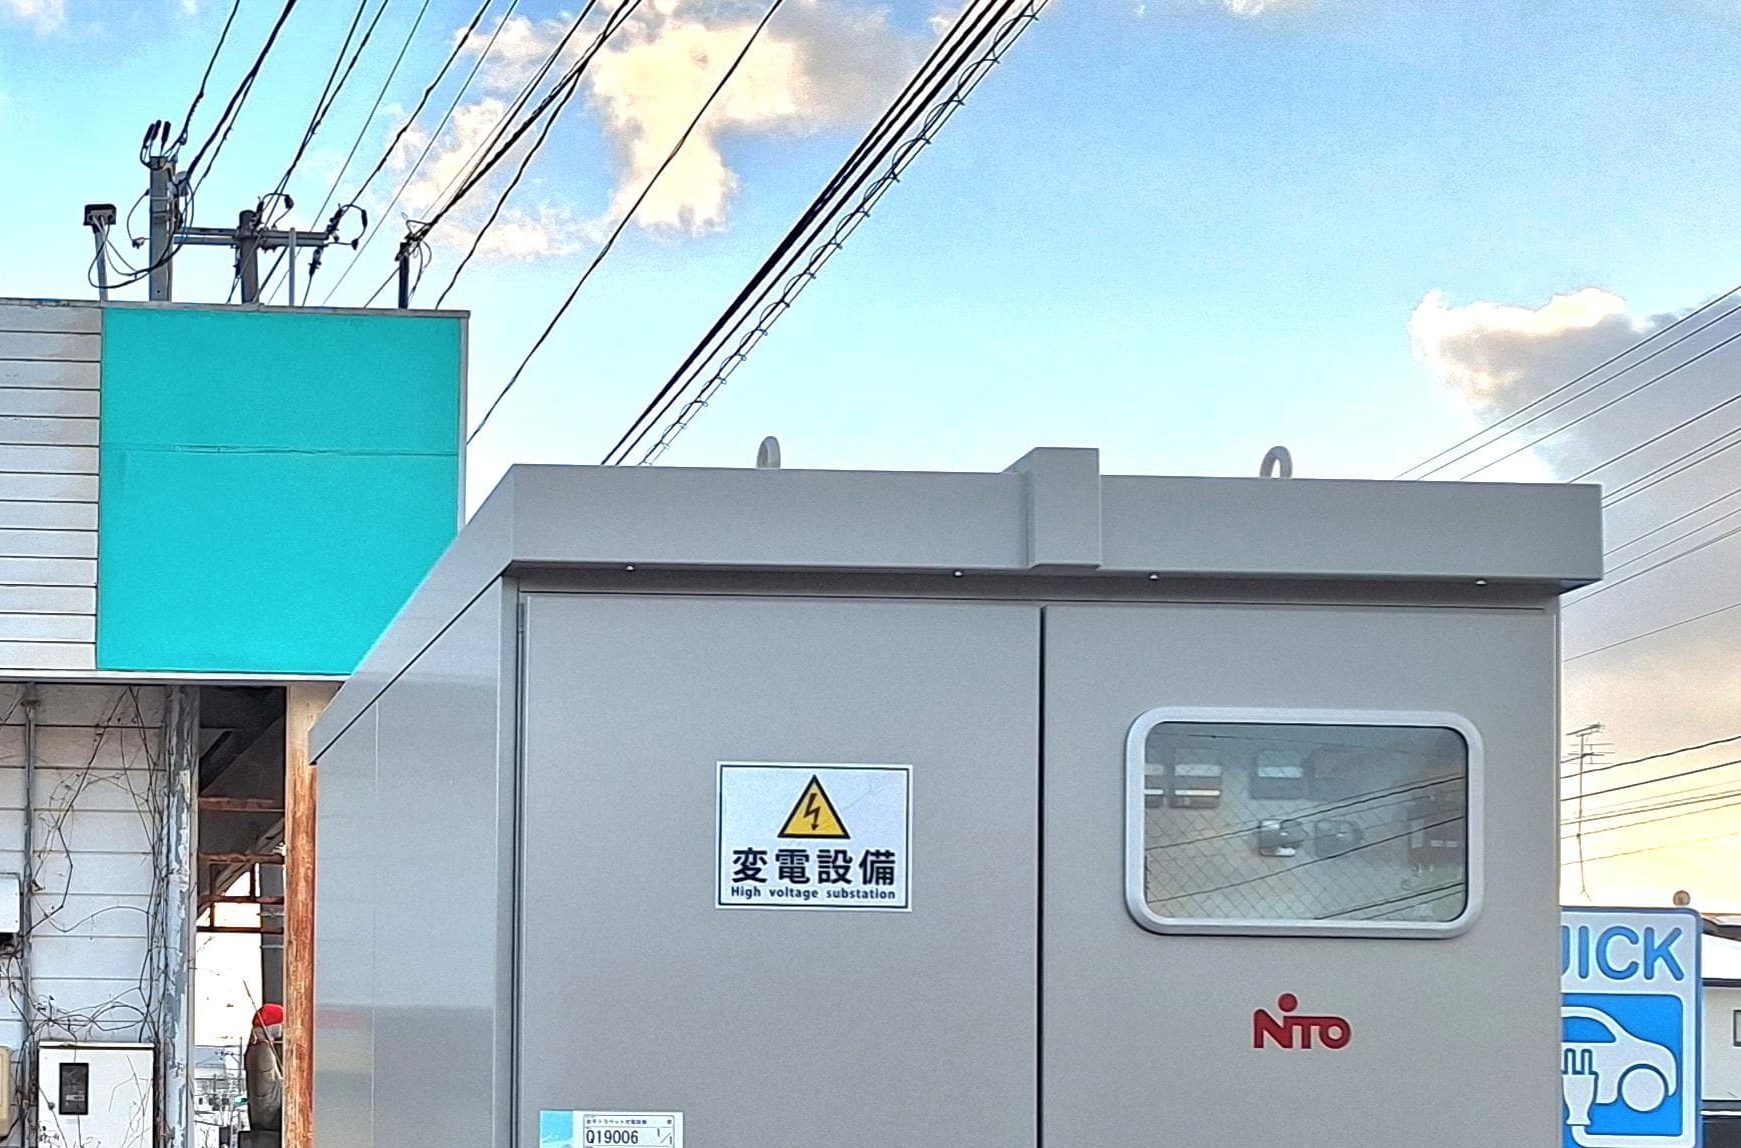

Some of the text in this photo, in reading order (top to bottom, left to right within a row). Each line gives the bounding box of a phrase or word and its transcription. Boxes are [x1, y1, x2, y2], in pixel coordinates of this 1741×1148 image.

[731, 847, 896, 886] 変電設備
[731, 886, 896, 901] High voltage substation
[1561, 926, 1685, 981] ICK
[586, 1129, 639, 1145] Q19006
